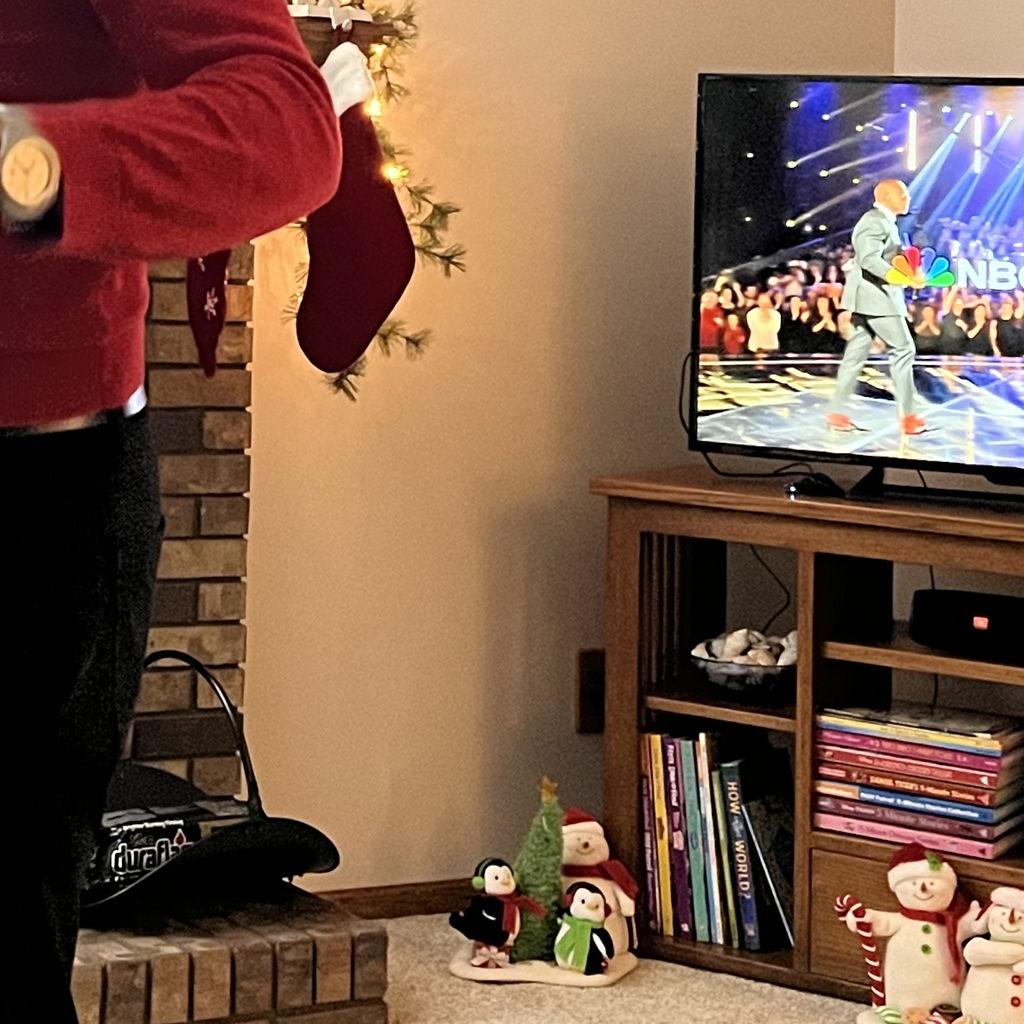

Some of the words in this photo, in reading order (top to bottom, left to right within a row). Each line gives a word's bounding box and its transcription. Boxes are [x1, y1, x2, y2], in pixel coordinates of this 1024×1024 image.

[958, 257, 1024, 292] NB
[727, 781, 742, 815] HOW
[733, 839, 752, 900] WORLD?
